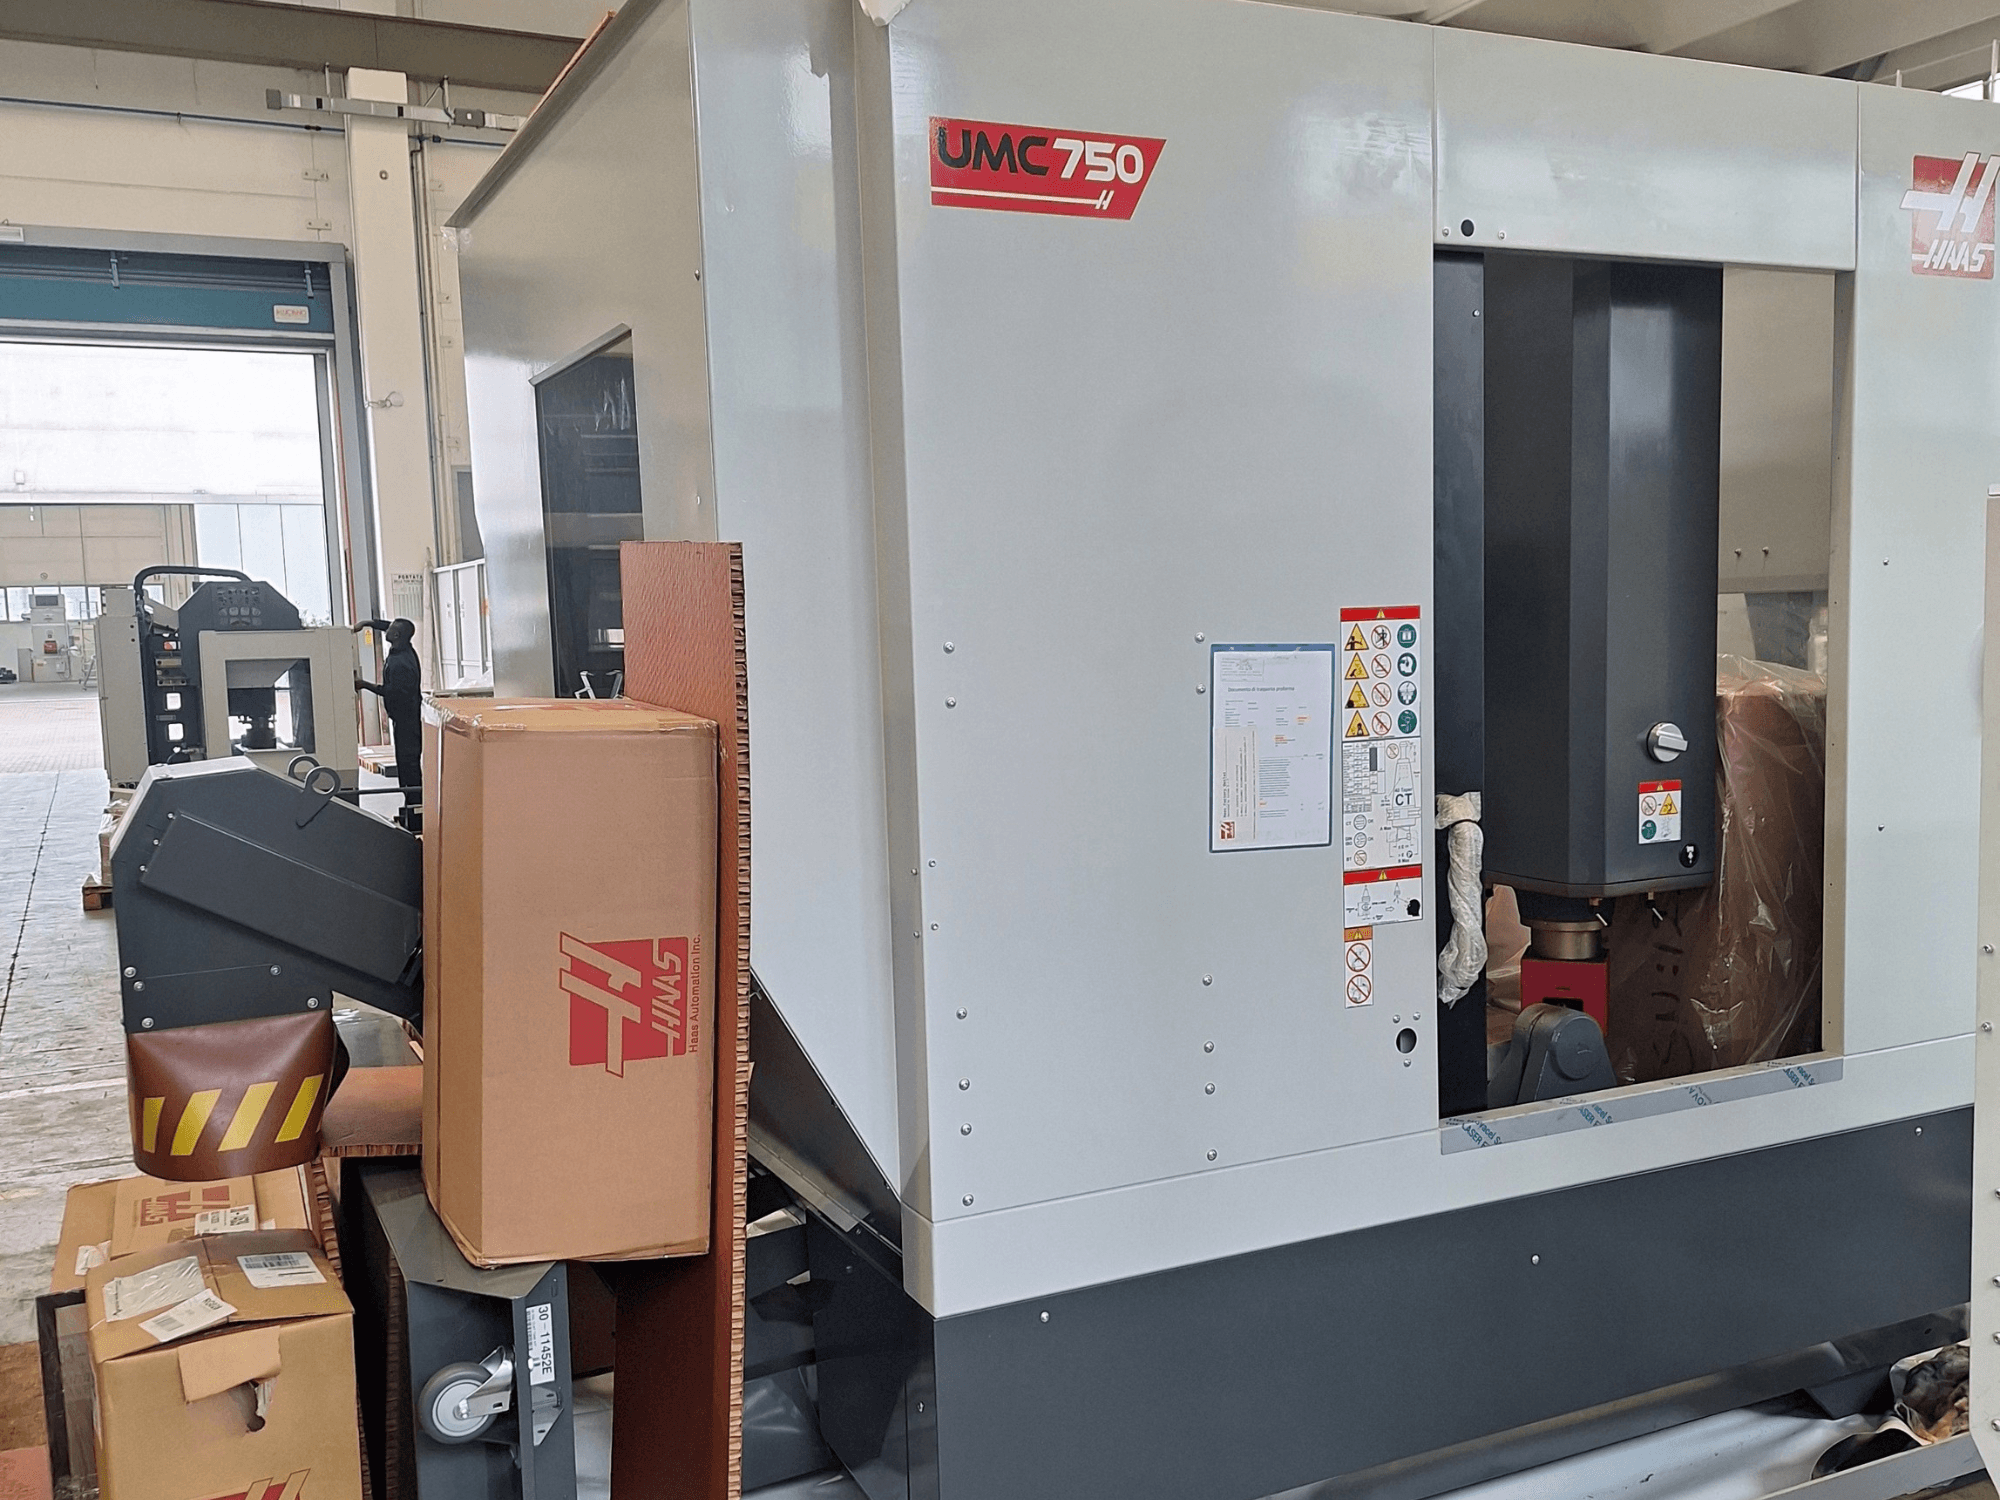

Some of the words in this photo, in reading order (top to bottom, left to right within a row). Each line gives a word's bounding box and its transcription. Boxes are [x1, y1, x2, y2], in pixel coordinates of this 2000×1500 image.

[938, 126, 1050, 177] UMC
[1052, 137, 1145, 185] 750
[1912, 239, 1995, 273] HAAS
[1395, 793, 1413, 806] CT
[691, 933, 701, 956] Inc.
[652, 938, 682, 1057] HAAS
[690, 956, 701, 1023] Automation
[688, 1025, 699, 1053] Haas
